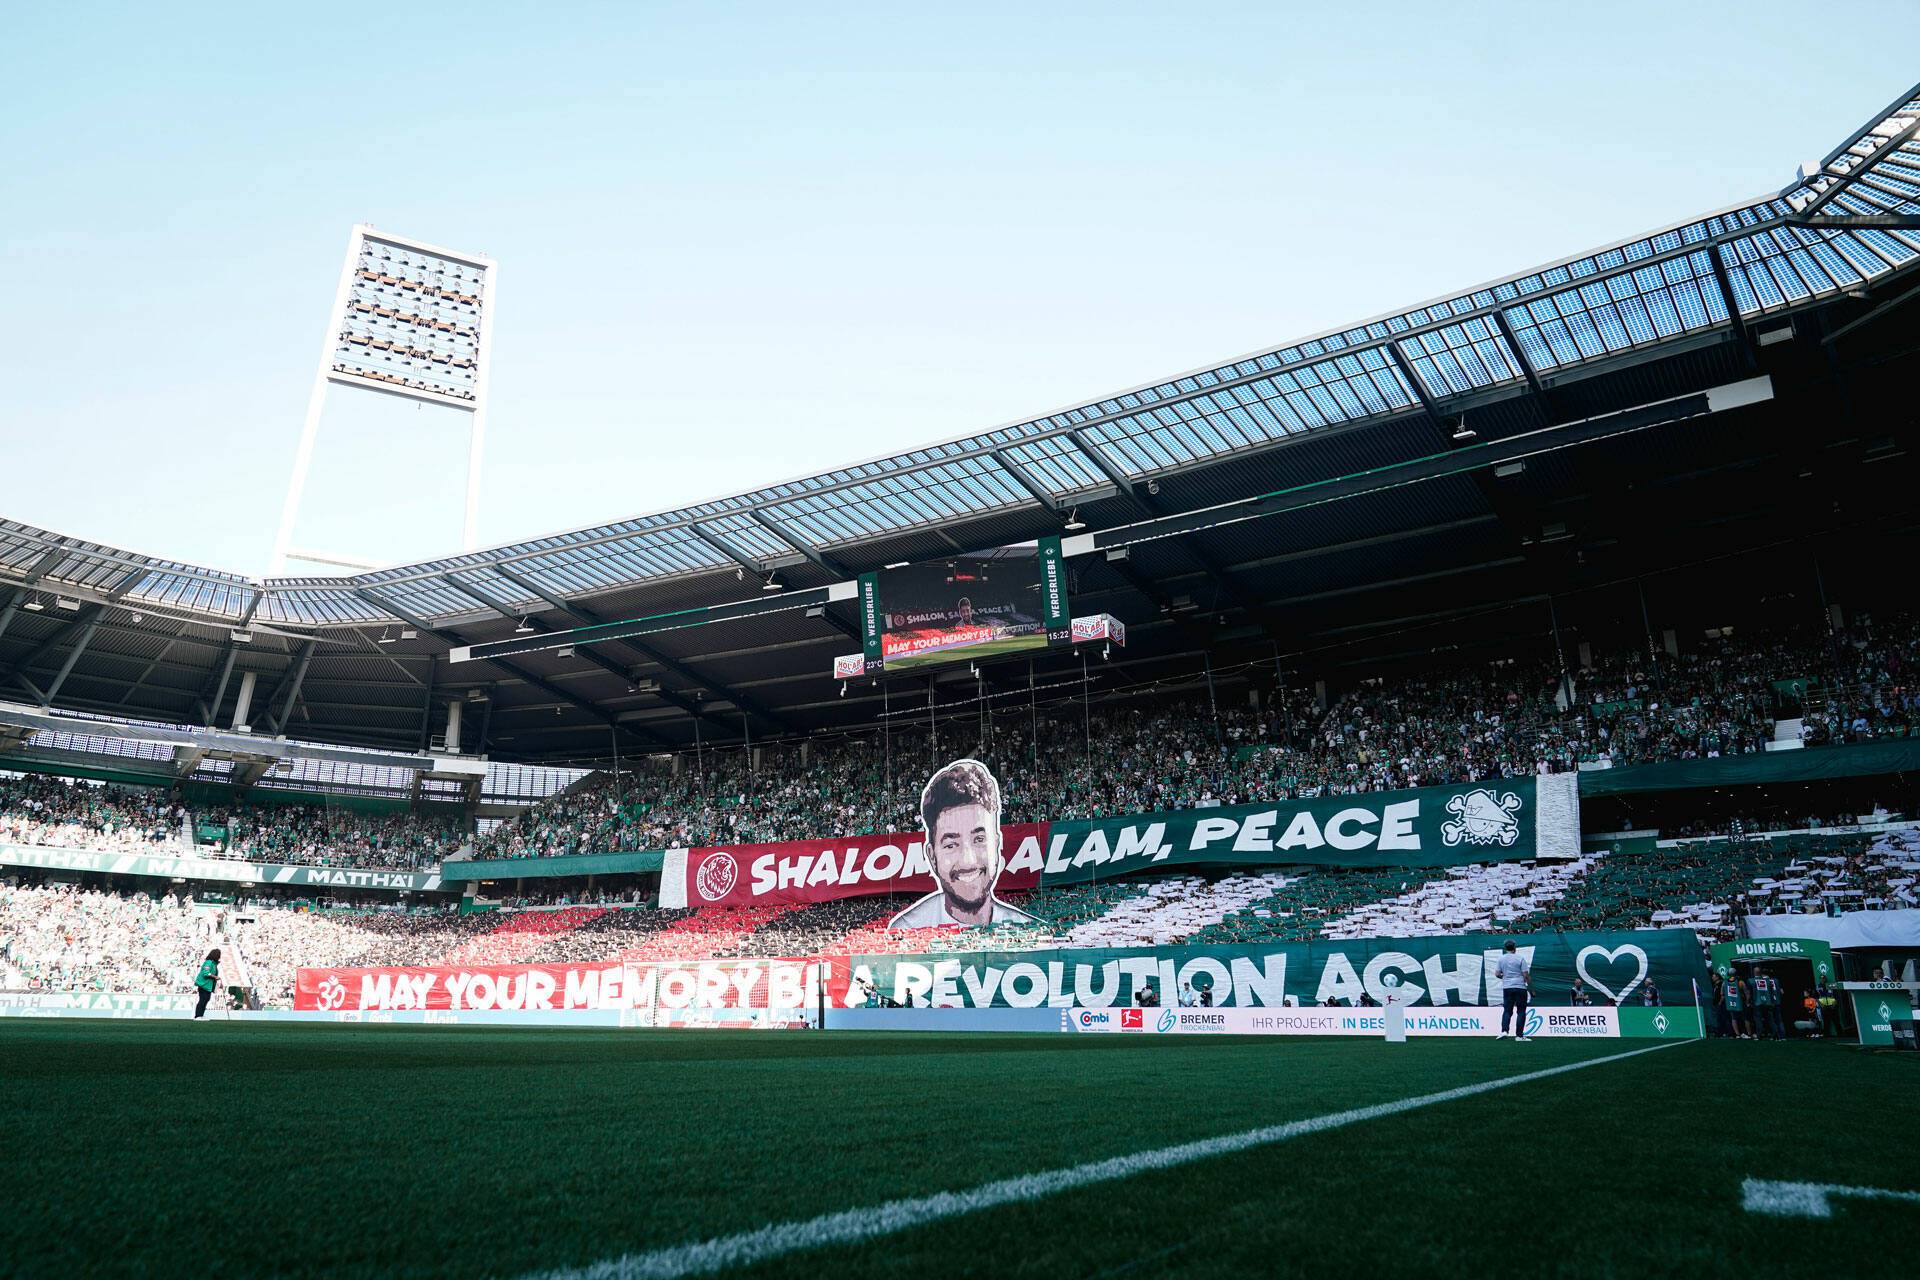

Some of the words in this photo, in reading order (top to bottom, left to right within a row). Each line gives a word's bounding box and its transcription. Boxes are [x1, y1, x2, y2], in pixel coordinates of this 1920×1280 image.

[1046, 559, 1057, 619] WERDERLIEBE
[865, 581, 874, 638] WERDERLIEBE
[887, 641, 911, 655] MAY
[913, 635, 940, 649] YOUR
[941, 629, 978, 645] MEMORY
[1048, 630, 1069, 641] 15:22
[866, 659, 883, 669] 23°C
[1000, 823, 1172, 874] ALAM,
[1189, 799, 1421, 851] PEACE
[1729, 834, 1745, 843] 124
[0, 847, 99, 868] ATTHÄI
[147, 855, 263, 881] MATTHÄI
[307, 869, 413, 888] MATTHÄI
[1736, 943, 1767, 954] MOIN
[1769, 942, 1804, 953] FANS.
[359, 972, 437, 1010] MAY
[444, 970, 556, 1010] YOUR
[564, 965, 762, 1009] MEMORY
[770, 960, 832, 1008] BE
[844, 965, 879, 1008] A
[64, 993, 193, 1011] MATTHÄ
[1080, 1011, 1109, 1027] Combi
[1181, 1014, 1225, 1024] BREMER
[1252, 1017, 1273, 1029] IHR
[1277, 1017, 1338, 1029] PROJEKT.
[1343, 1017, 1356, 1029] IN
[1360, 1017, 1414, 1029] BESN
[1418, 1015, 1484, 1030] HÄNDEN.
[1549, 1015, 1606, 1026] BREMER
[1549, 1026, 1608, 1034] TROCKENBAU
